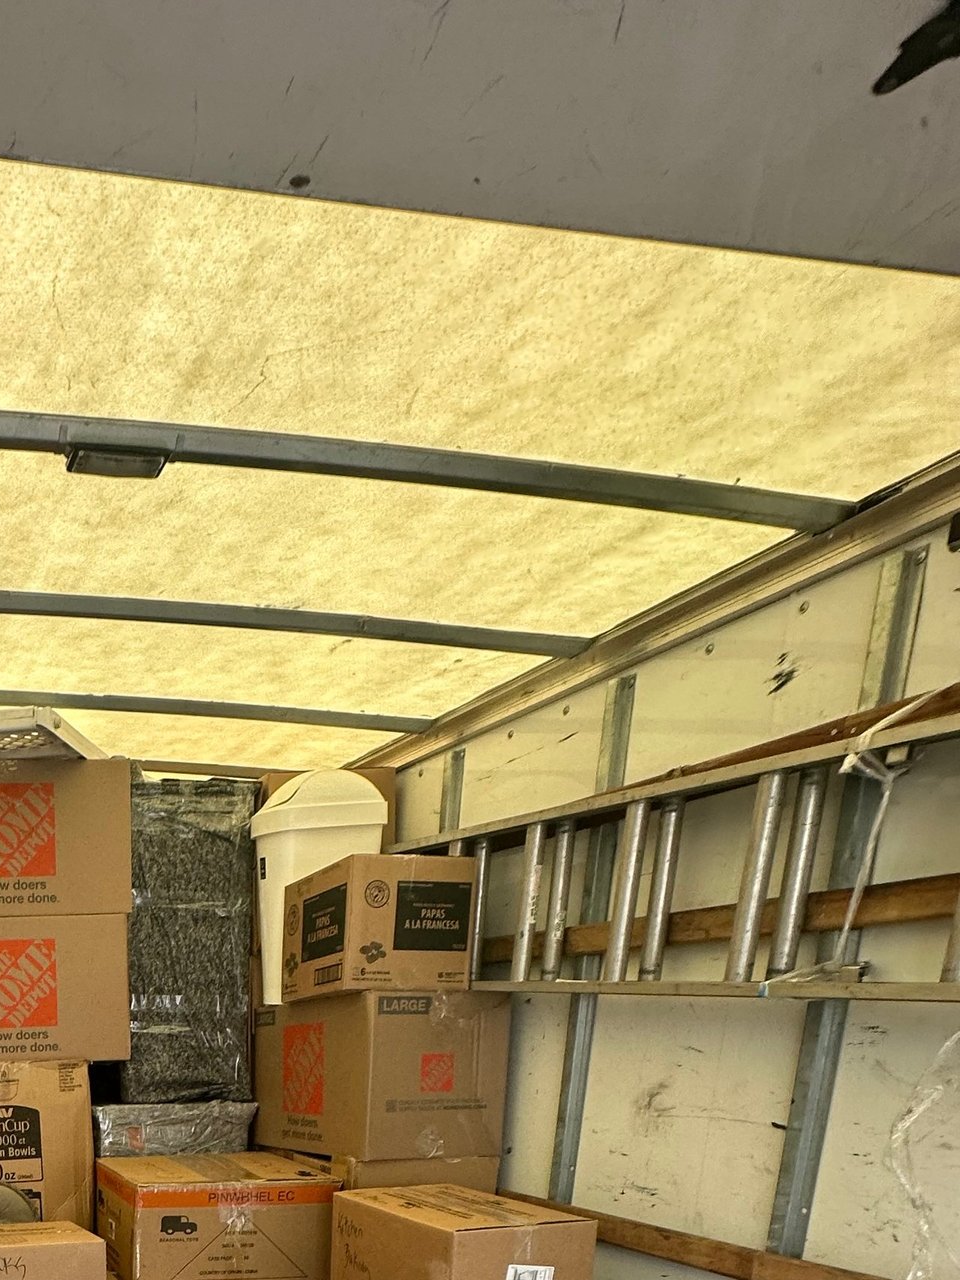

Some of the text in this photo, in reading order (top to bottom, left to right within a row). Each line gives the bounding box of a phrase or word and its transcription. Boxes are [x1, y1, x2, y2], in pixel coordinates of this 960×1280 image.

[5, 815, 56, 878] DEPOT
[13, 879, 47, 891] doers
[27, 893, 60, 904] done.
[421, 908, 446, 919] PAPAS
[422, 920, 460, 930] FRANCESA
[7, 972, 58, 1028] DEPOT
[382, 999, 427, 1012] LARGE
[16, 1030, 49, 1041] doers
[30, 1042, 62, 1053] done.
[18, 1137, 26, 1145] ct
[8, 1146, 37, 1157] Bowls
[4, 1172, 16, 1180] oz
[277, 1190, 296, 1201] EC
